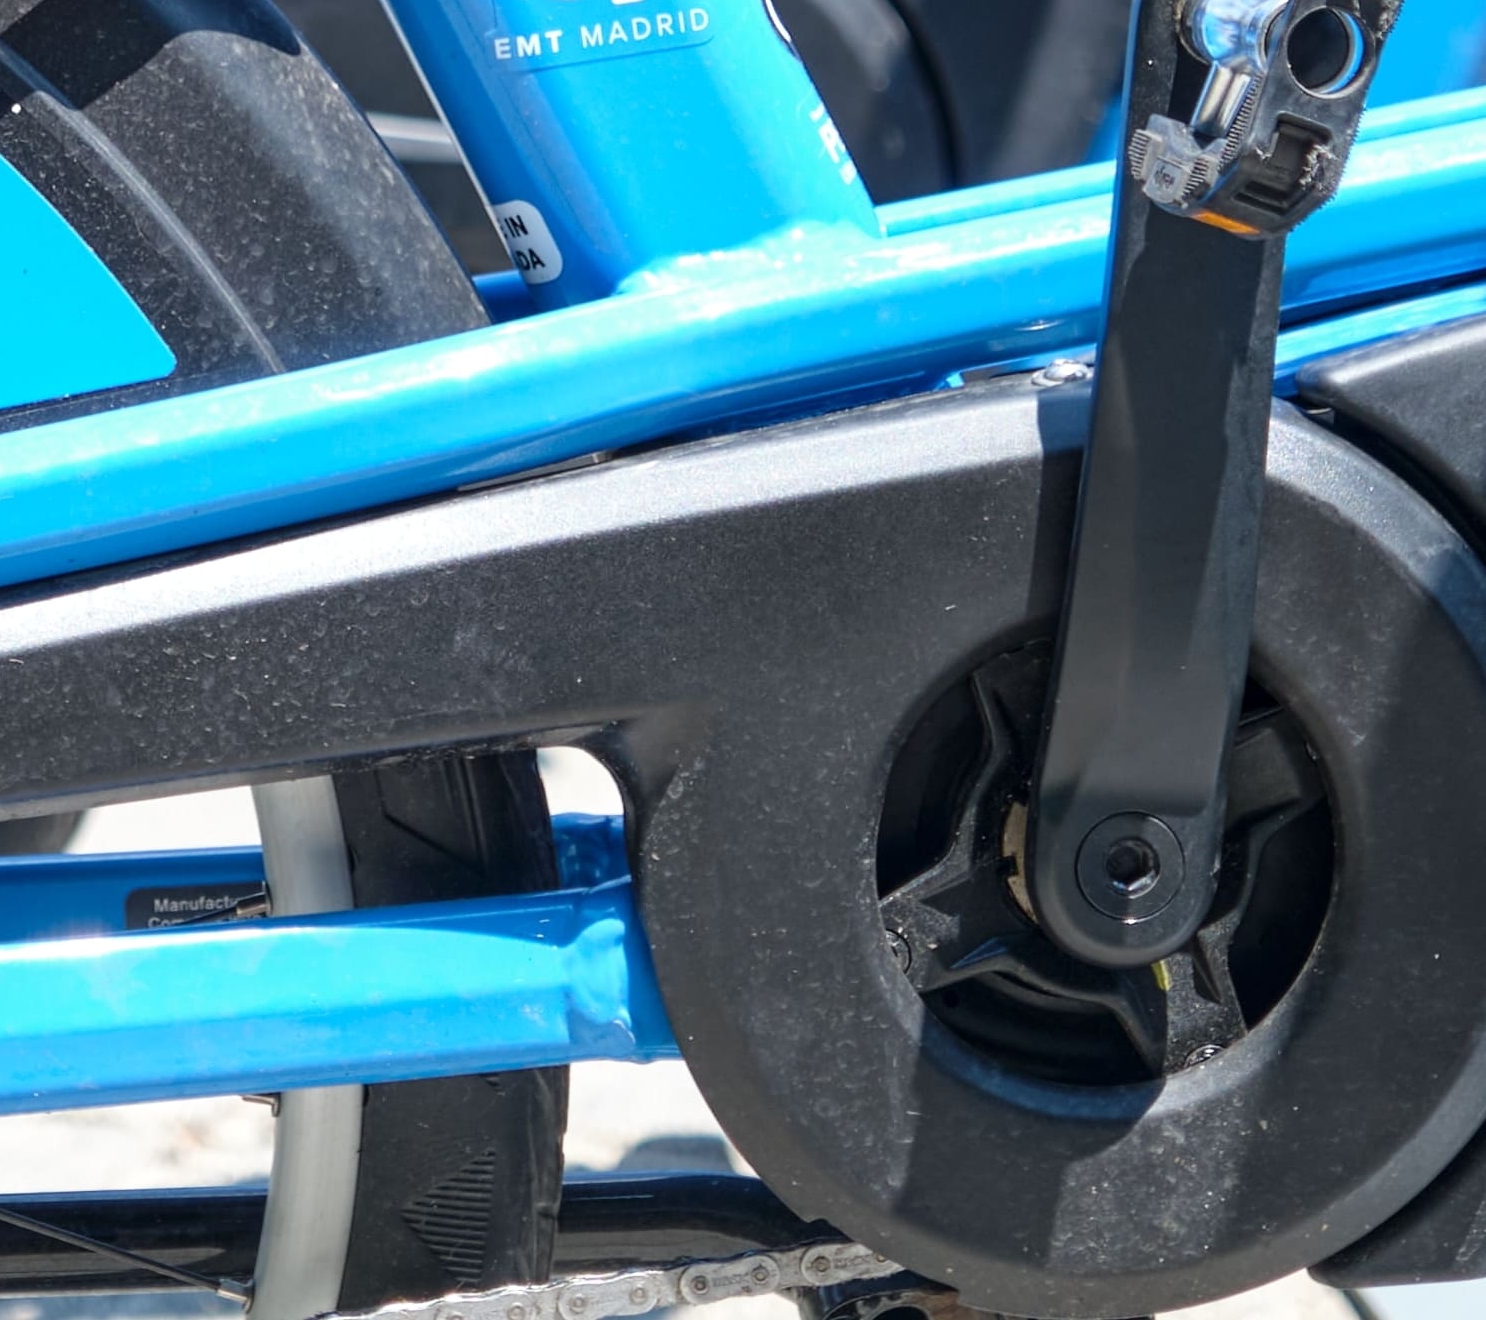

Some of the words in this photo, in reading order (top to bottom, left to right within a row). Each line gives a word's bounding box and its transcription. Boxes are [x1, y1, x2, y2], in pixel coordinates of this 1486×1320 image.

[494, 30, 563, 60] EMT
[581, 7, 710, 49] MADRID
[153, 895, 238, 913] Manufact
